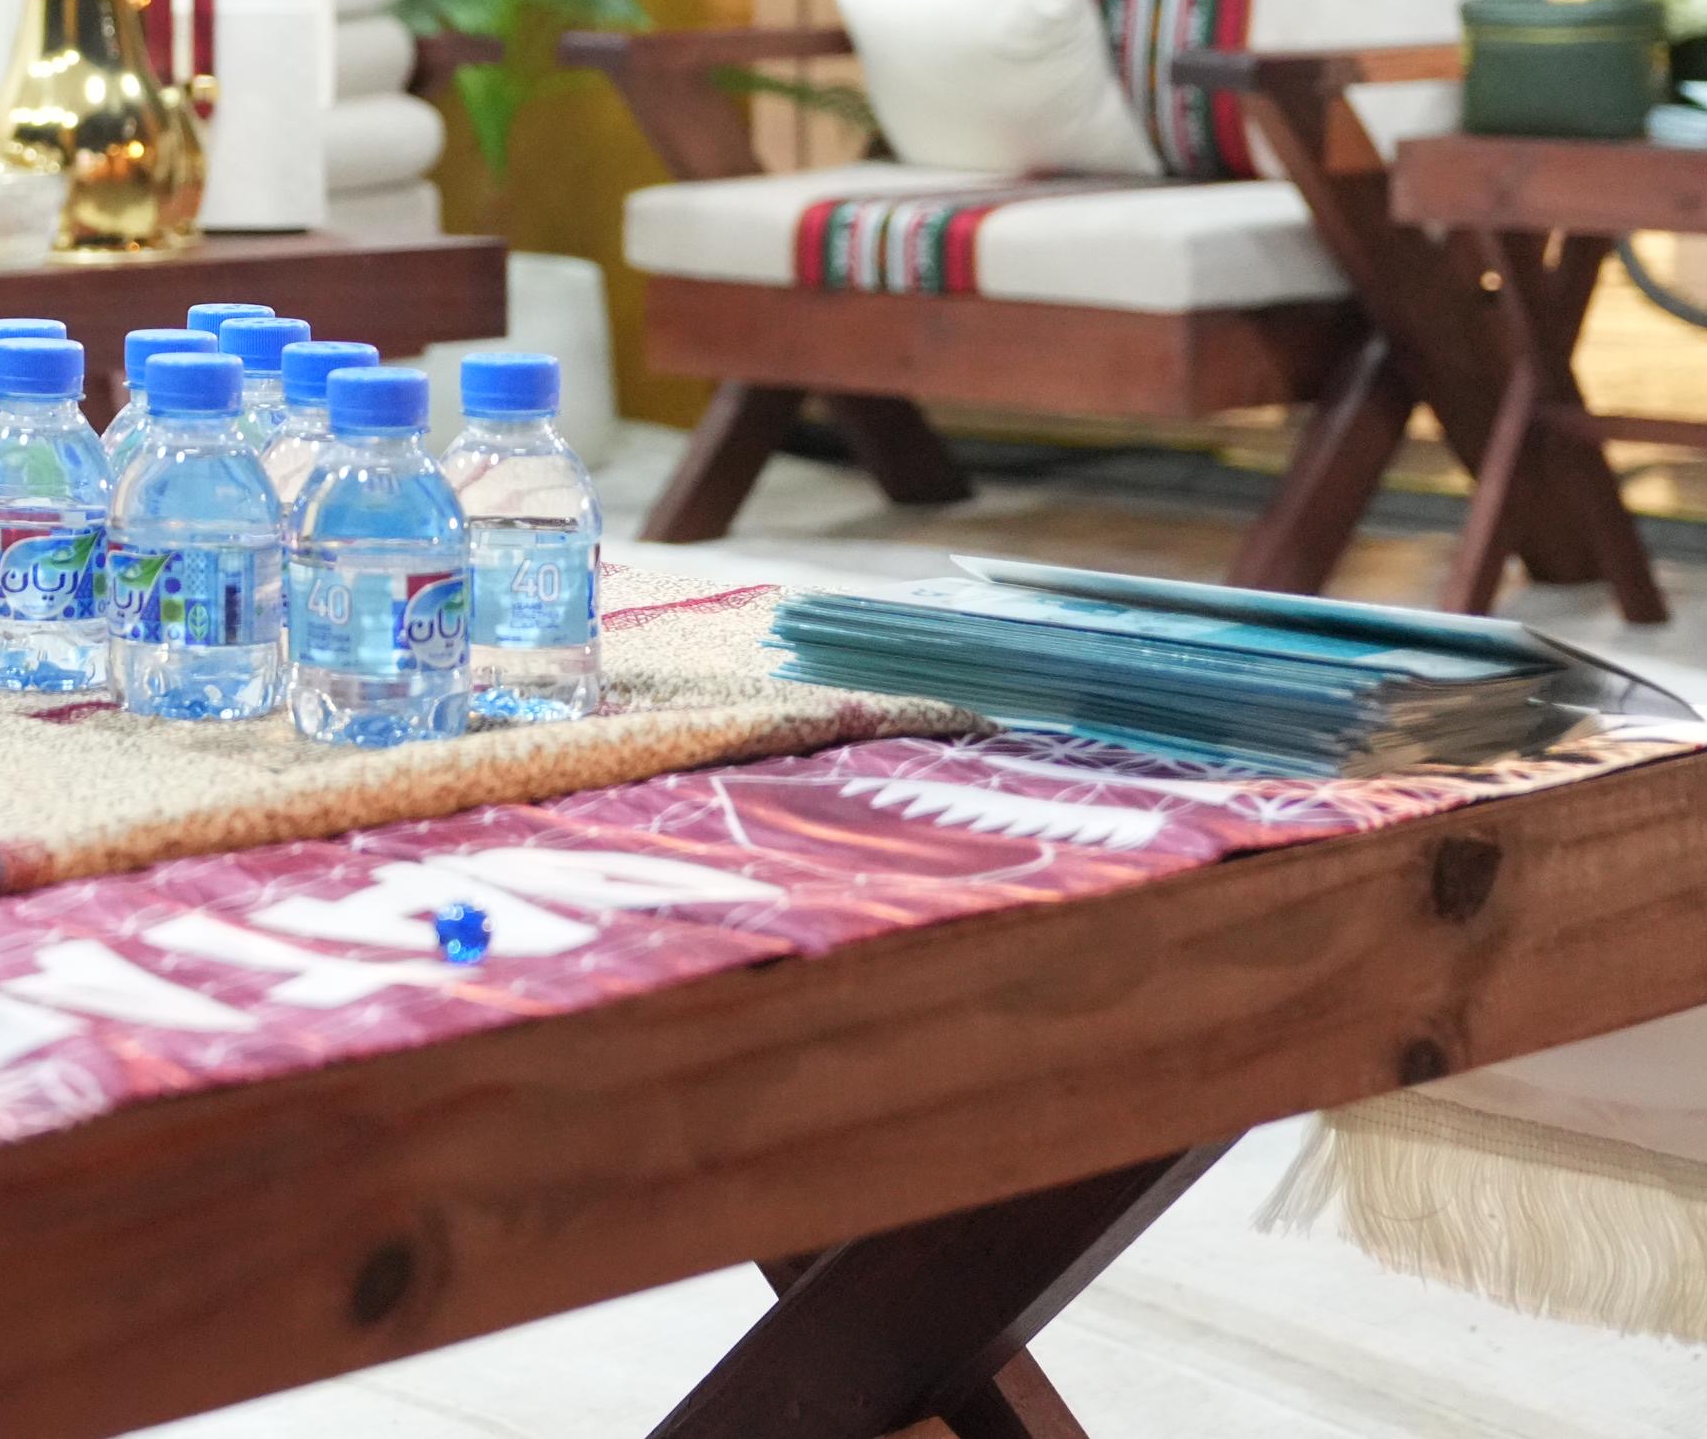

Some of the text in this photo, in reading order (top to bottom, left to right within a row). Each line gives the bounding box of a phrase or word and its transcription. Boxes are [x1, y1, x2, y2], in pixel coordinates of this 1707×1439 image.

[1, 561, 79, 602] ريان
[308, 578, 350, 625] 40
[511, 559, 561, 602] 40
